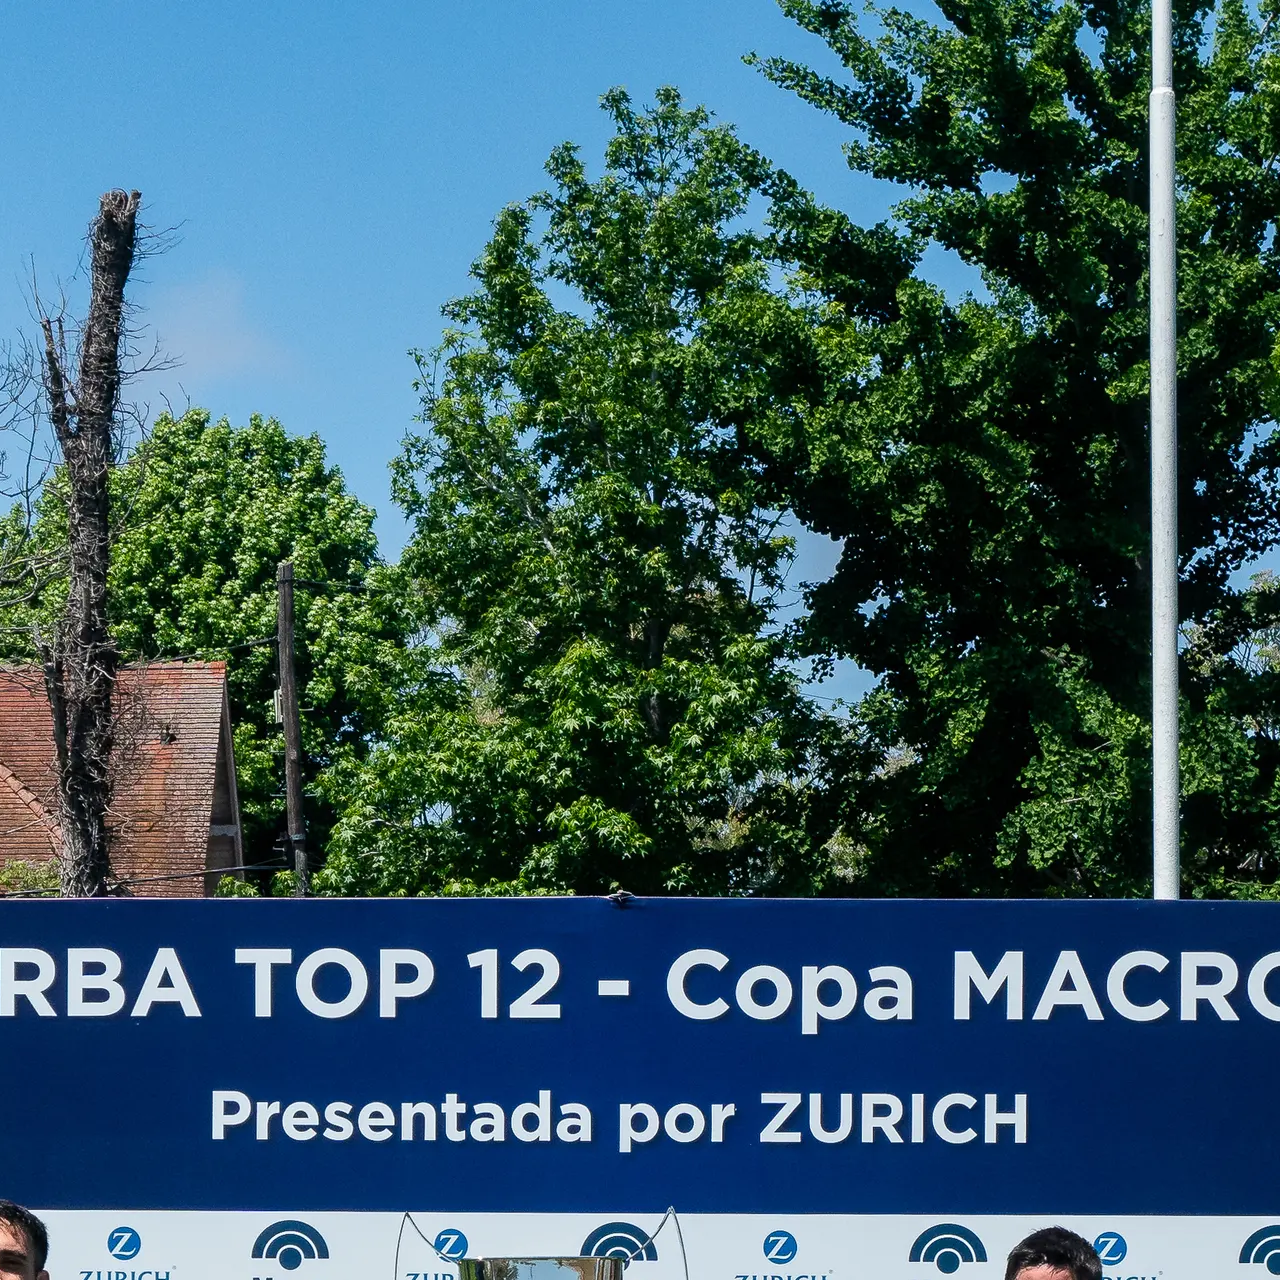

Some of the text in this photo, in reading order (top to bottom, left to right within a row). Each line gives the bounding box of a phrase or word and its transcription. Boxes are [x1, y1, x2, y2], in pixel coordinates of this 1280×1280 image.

[234, 948, 435, 1019] TOP
[467, 948, 562, 1019] 12
[666, 948, 913, 1035] Copa
[211, 1090, 1028, 1153] Presentada por ZURICH
